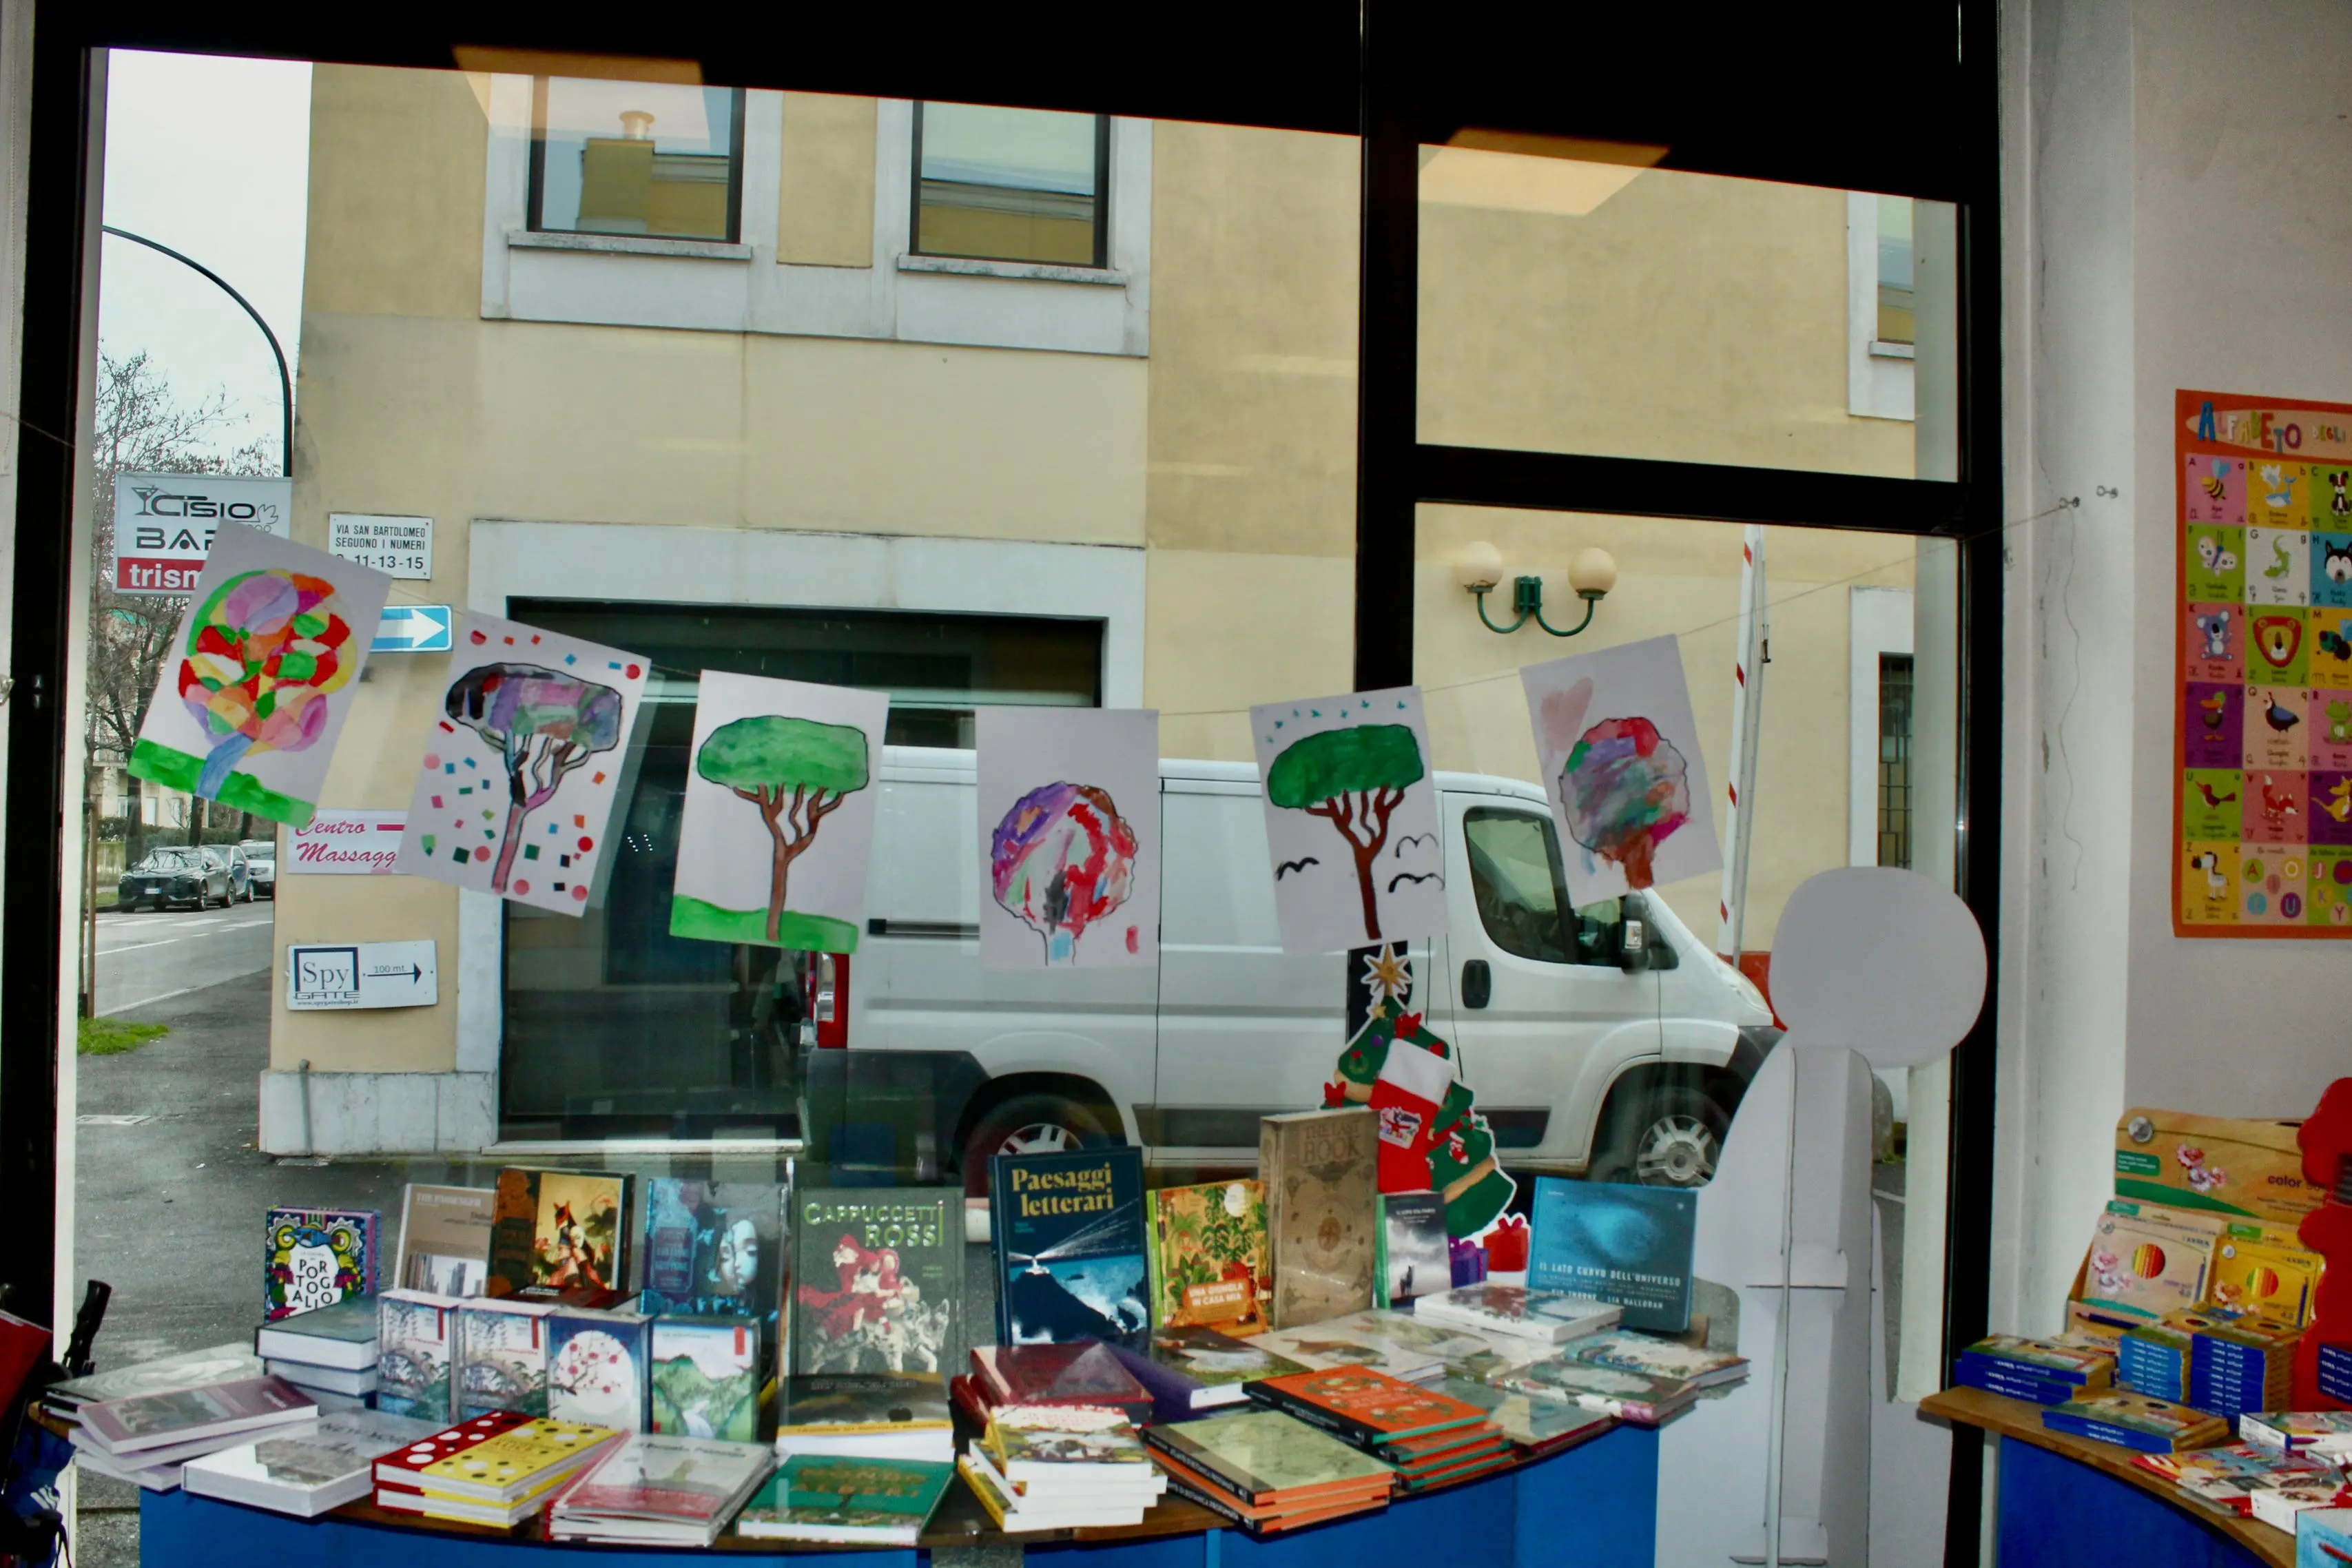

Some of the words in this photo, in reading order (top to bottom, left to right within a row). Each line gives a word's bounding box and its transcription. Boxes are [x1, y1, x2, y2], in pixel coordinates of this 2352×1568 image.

[2196, 401, 2302, 454] ALFABETO
[336, 524, 349, 535] VIA
[353, 525, 370, 535] SAN
[373, 526, 426, 538] BARTOLOMEO
[336, 537, 378, 548] SEGUONO
[382, 539, 385, 549] I
[390, 539, 425, 550] NUMERI
[296, 842, 397, 868] Massagg
[303, 961, 350, 990] Spy
[374, 964, 391, 973] 100
[294, 991, 360, 1000] GATE
[1303, 1135, 1363, 1165] BOOK
[1012, 1162, 1112, 1193] Paesaggi
[2267, 1174, 2302, 1188] color
[1020, 1186, 1114, 1217] letterari
[1539, 1261, 1547, 1272] IL
[1551, 1262, 1574, 1275] LATO
[1610, 1270, 1681, 1288] DELL'UNIVERSO
